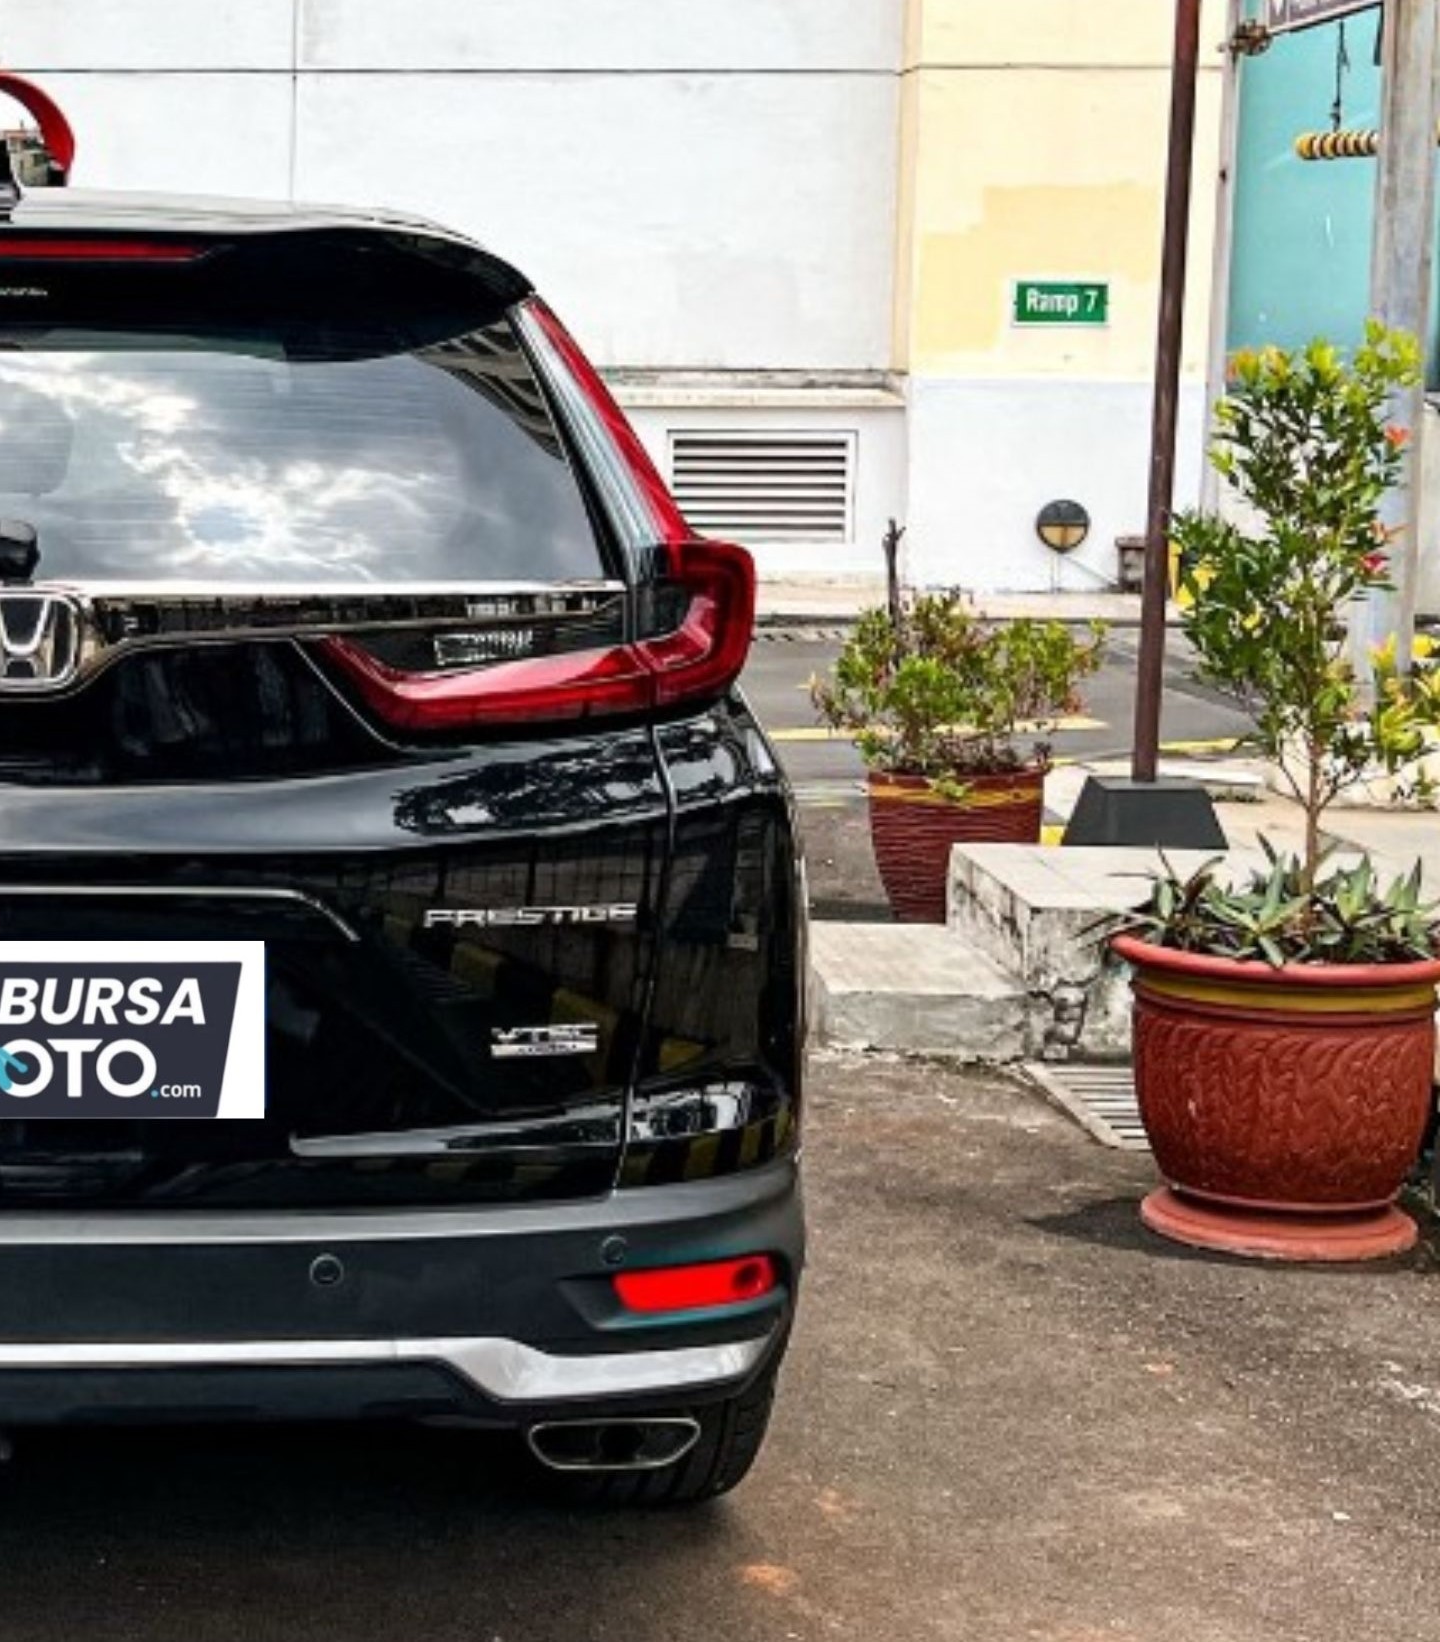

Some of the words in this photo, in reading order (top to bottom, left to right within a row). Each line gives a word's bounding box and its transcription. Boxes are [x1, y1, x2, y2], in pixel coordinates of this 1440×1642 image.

[1026, 287, 1078, 318] Ramp
[1084, 289, 1098, 312] 7
[424, 903, 638, 928] PRESTIGE
